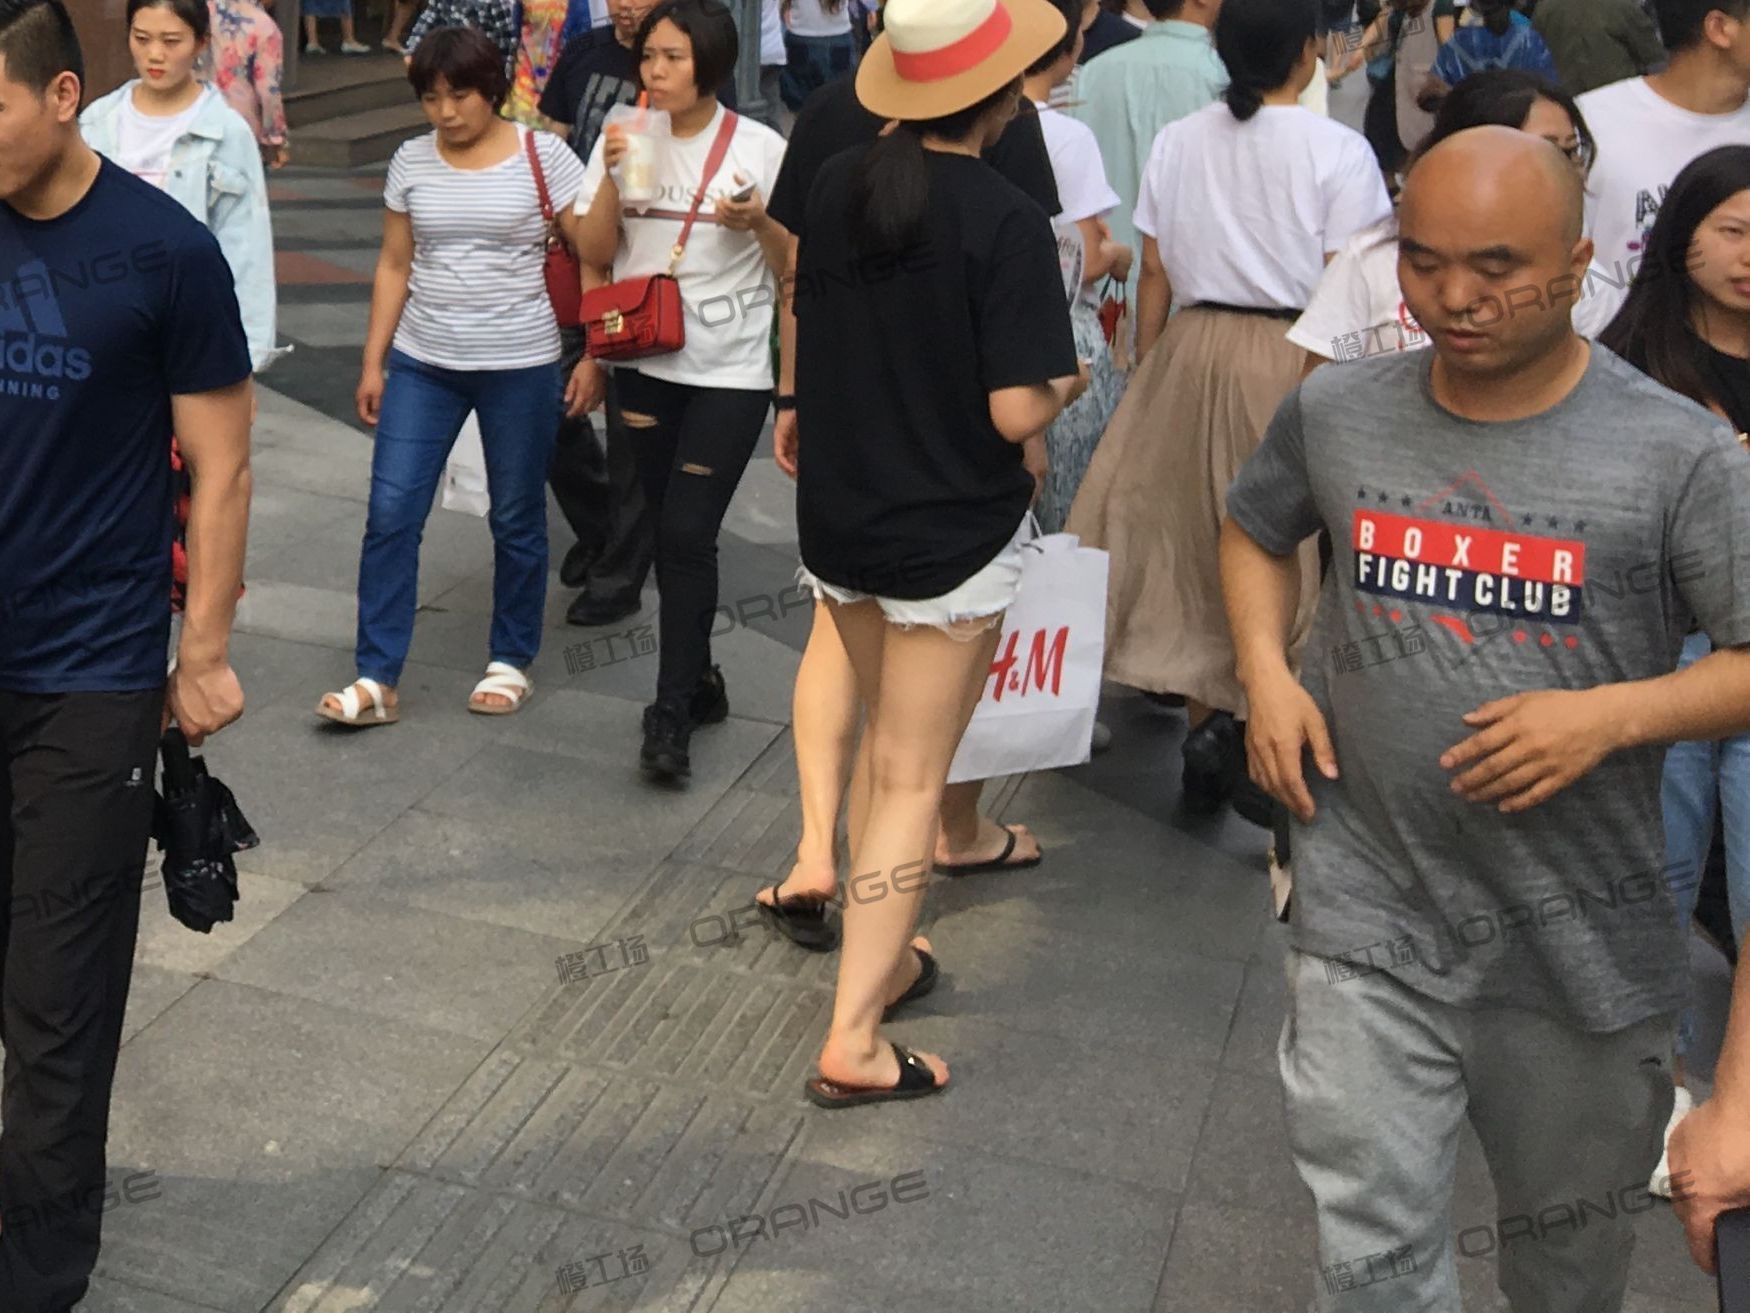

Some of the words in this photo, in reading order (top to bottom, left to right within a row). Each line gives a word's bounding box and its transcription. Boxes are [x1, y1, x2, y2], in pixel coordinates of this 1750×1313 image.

[1442, 502, 1491, 522] ANTA
[1359, 519, 1574, 583] BOXER
[1359, 553, 1463, 601] FIGHT
[1474, 573, 1571, 617] CLUB
[988, 625, 1069, 702] H&M
